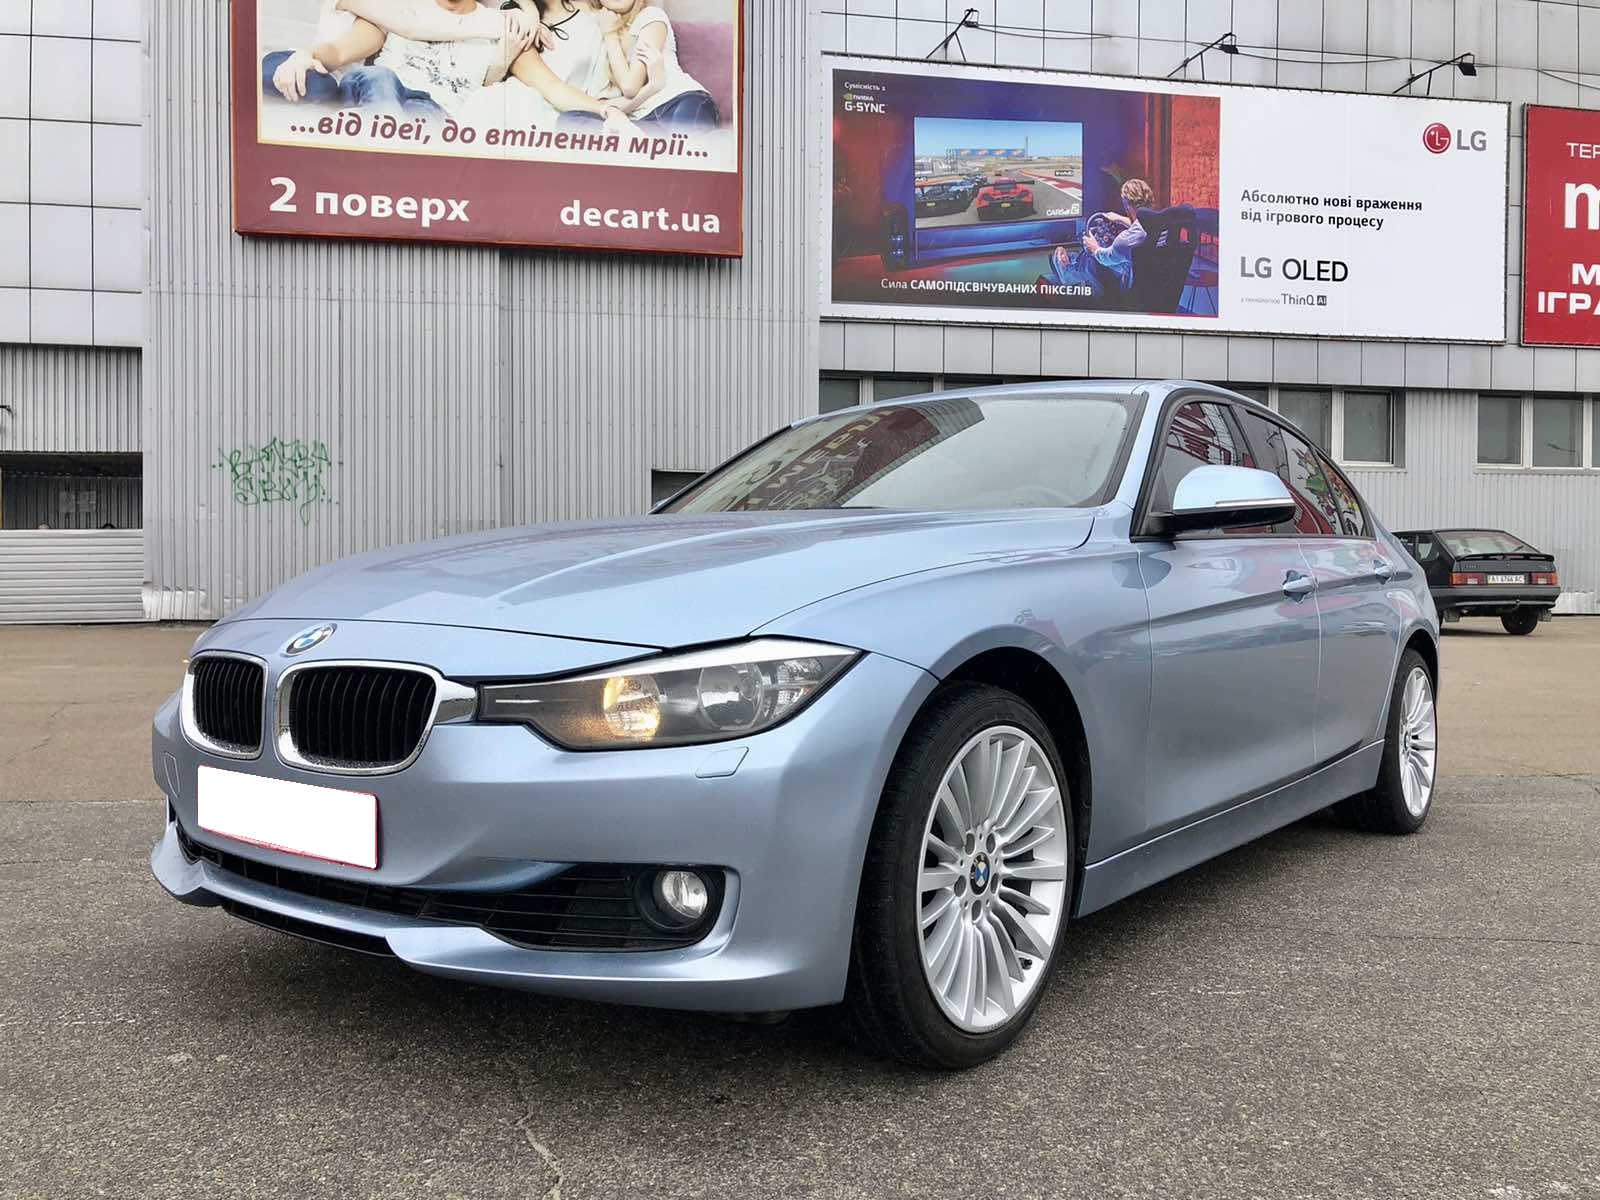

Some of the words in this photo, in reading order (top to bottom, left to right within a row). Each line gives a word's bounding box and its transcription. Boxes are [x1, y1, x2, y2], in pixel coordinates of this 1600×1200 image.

[844, 101, 886, 114] G-SYNC
[290, 111, 362, 136] ...від
[370, 114, 431, 145] ідеї,
[442, 118, 476, 143] до
[485, 124, 620, 152] втілення
[628, 132, 709, 160] мрії...
[1456, 129, 1487, 151] LG
[269, 177, 297, 213] 2
[315, 190, 471, 227] поверх
[1241, 189, 1319, 206] Абсолютно
[1323, 195, 1352, 208] нові
[1356, 198, 1423, 212] враження
[560, 200, 721, 234] decart.ua
[1241, 208, 1262, 223] від
[1266, 209, 1324, 226] ігрового
[1328, 214, 1384, 231] процесу
[1240, 256, 1272, 279] LG
[1282, 258, 1349, 282] OLED
[881, 278, 908, 289] Сила
[911, 279, 1038, 294] САМОПІДСВІЧУВАНИХ
[1040, 284, 1092, 296] ПІКСЕЛІВ
[1281, 293, 1315, 306] ThinQ
